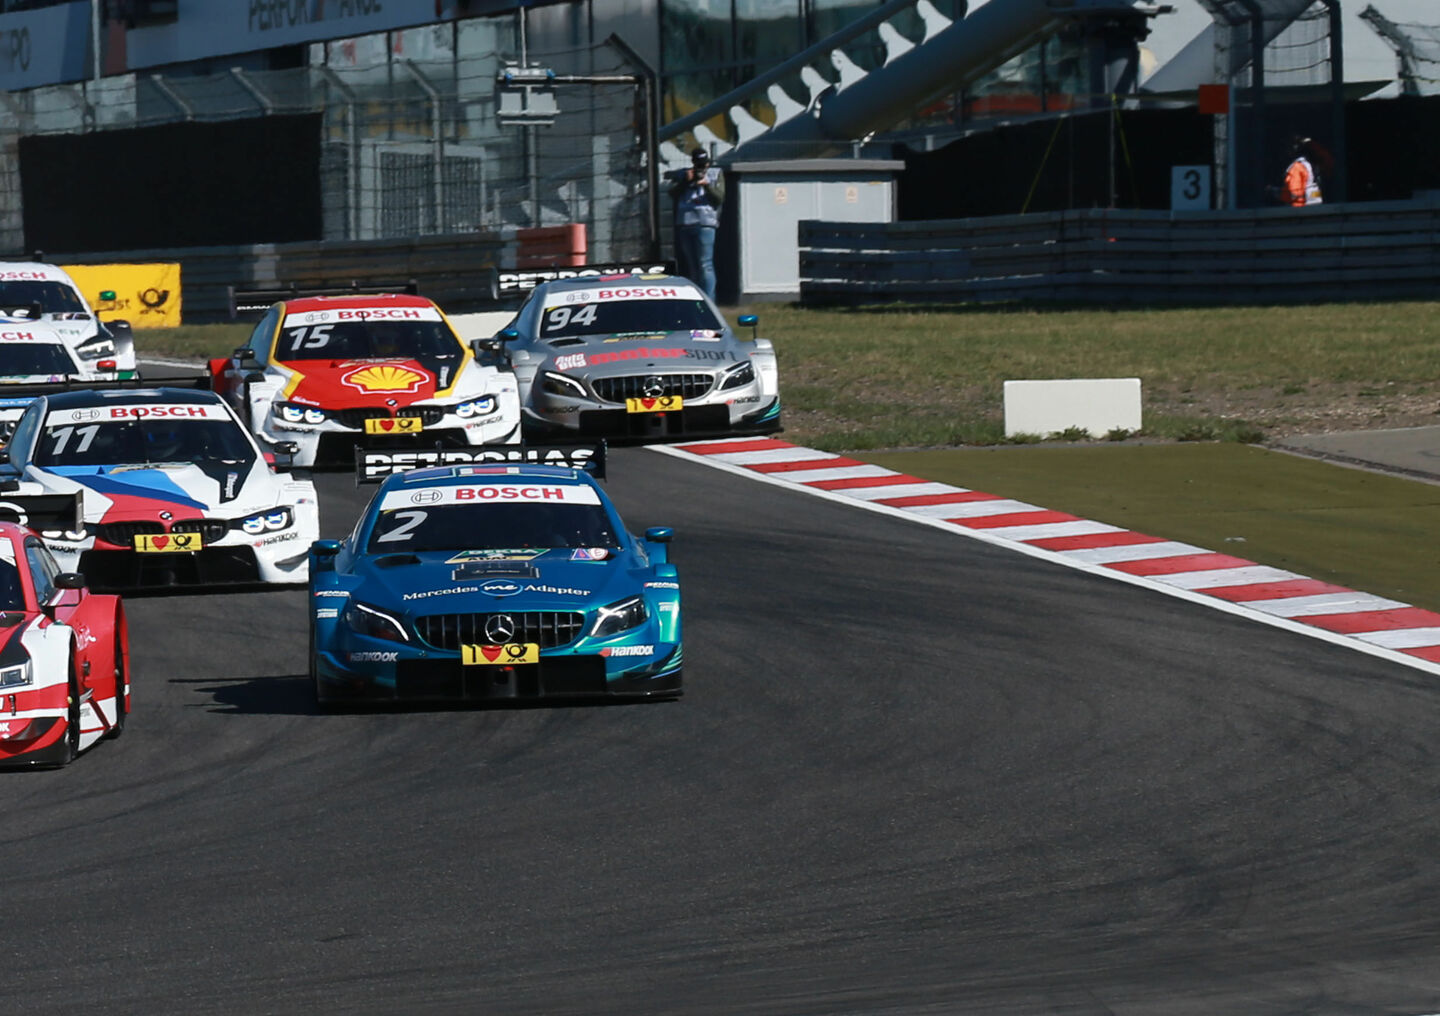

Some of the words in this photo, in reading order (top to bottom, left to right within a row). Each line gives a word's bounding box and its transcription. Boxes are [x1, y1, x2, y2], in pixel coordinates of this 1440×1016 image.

[1182, 169, 1201, 201] 3
[598, 288, 676, 300] BOSCH
[337, 309, 420, 319] BOSCH
[546, 305, 598, 332] 94
[288, 325, 335, 351] 15
[588, 346, 688, 365] motor
[684, 348, 737, 362] sport
[110, 407, 208, 419] BOSCH
[50, 425, 101, 456] 11
[455, 487, 565, 500] BOSCH
[376, 510, 429, 543] 2
[403, 585, 479, 601] Mercedes
[524, 584, 592, 597] Adapter
